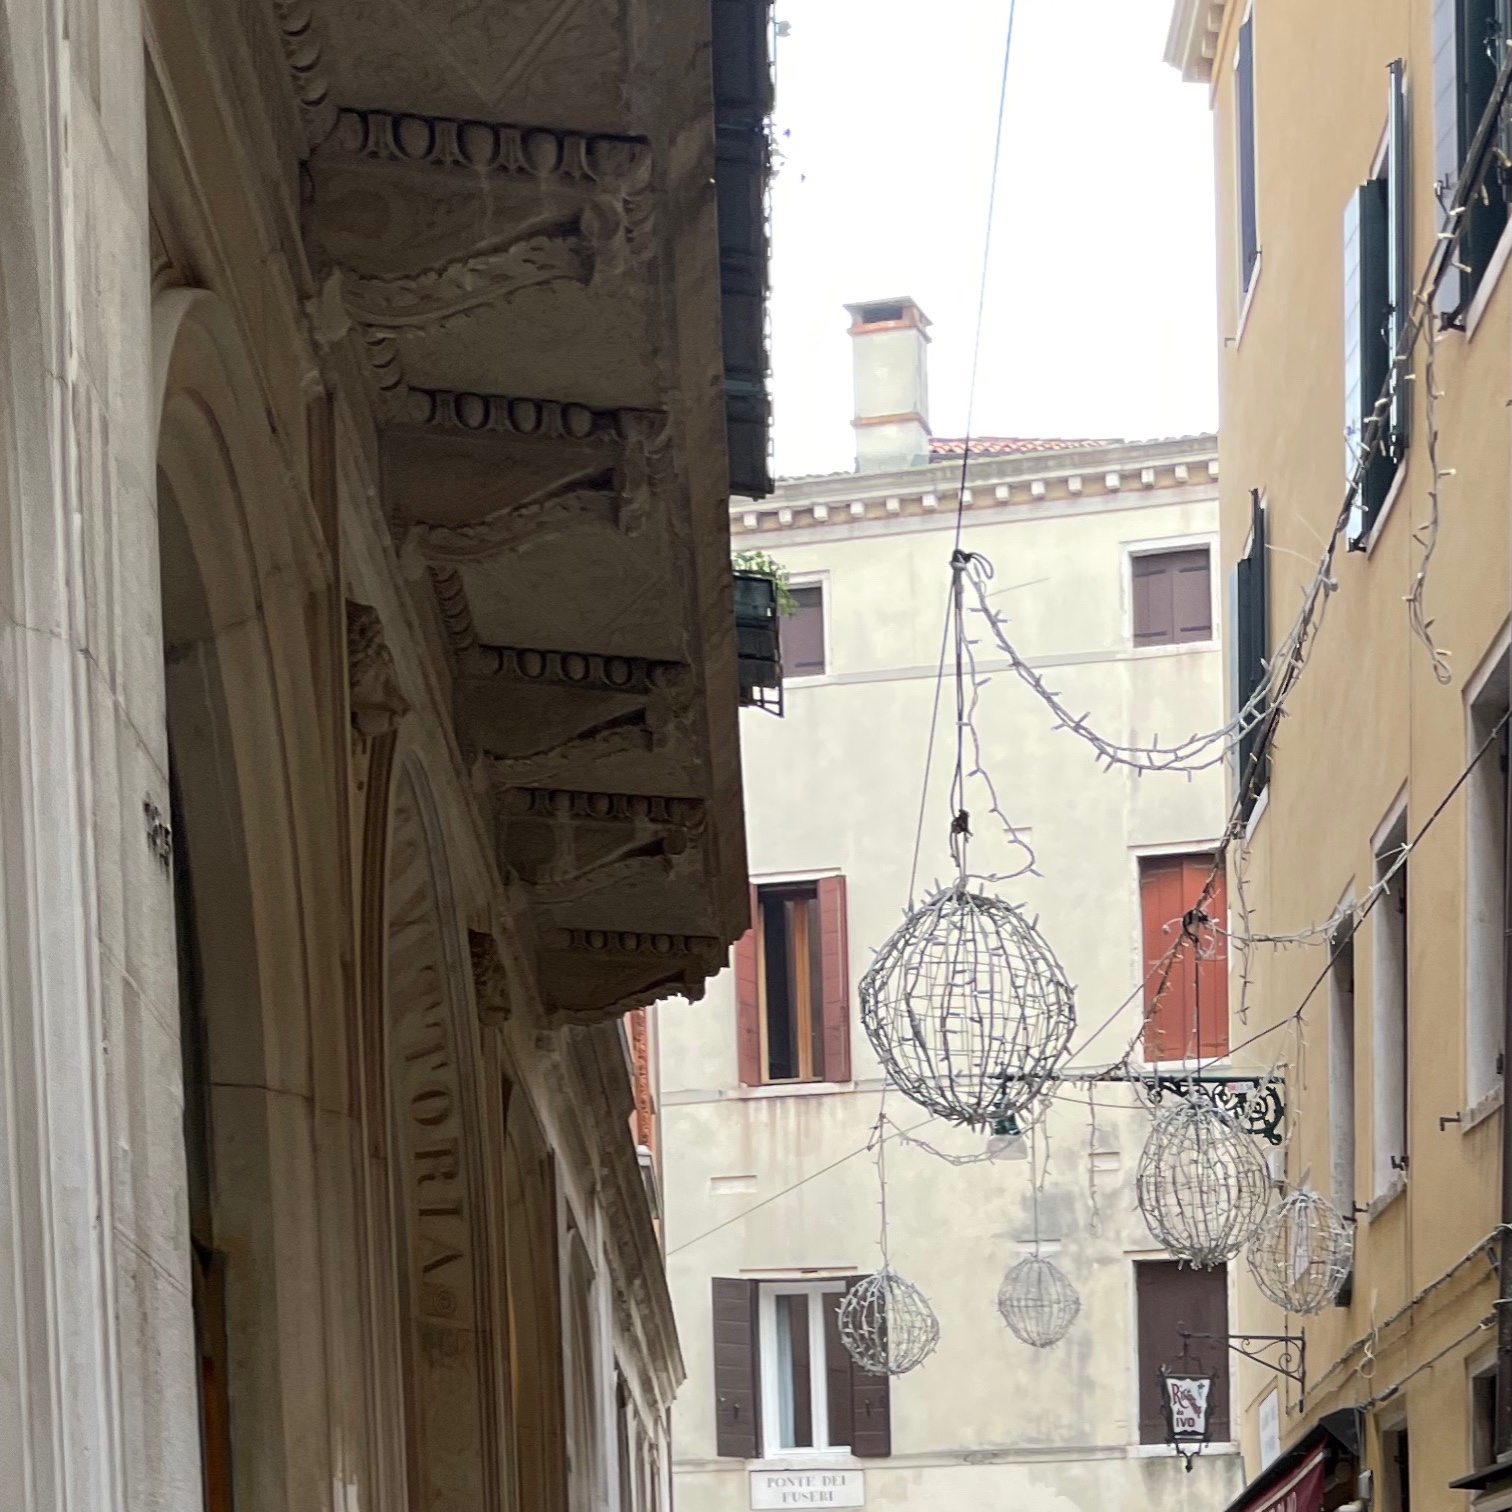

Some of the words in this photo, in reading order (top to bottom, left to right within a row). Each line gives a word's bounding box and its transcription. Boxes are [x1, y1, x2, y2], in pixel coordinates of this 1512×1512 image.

[1175, 1417, 1195, 1428] IVO
[766, 1476, 815, 1488] PONTE
[822, 1475, 846, 1486] DEI
[782, 1490, 834, 1503] FUSERI
